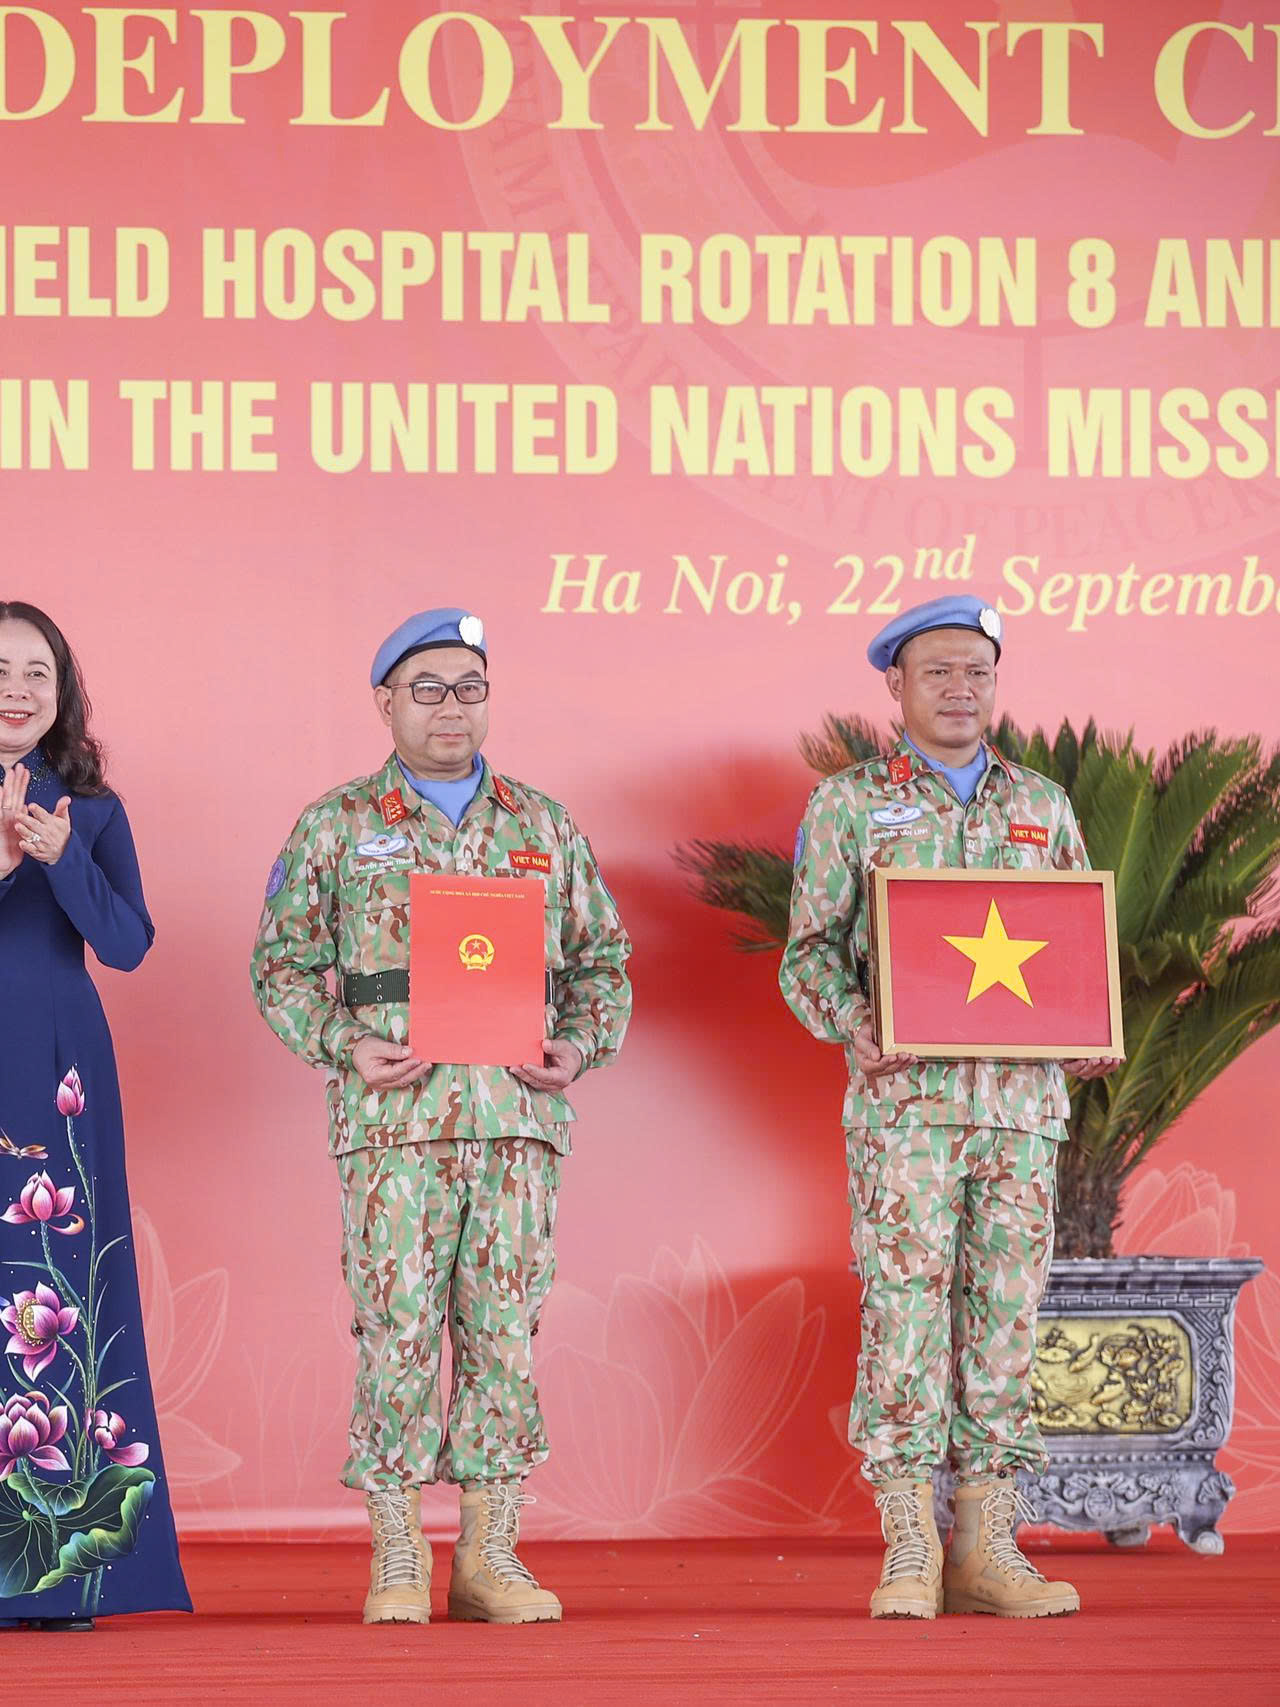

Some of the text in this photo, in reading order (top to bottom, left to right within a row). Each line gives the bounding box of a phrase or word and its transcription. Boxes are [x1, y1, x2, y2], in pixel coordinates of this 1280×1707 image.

[1154, 21, 1280, 138] C
[202, 227, 611, 324] HOSPITAL
[640, 233, 1037, 328] ROTATION
[1067, 236, 1117, 329] 8
[1143, 238, 1280, 328] AN
[0, 378, 89, 471] IN
[119, 380, 278, 472] THE
[310, 382, 619, 475] UNITED
[650, 385, 1017, 478] NATIONS
[1047, 387, 1280, 480] MISS
[541, 554, 640, 615] Ha
[663, 554, 802, 622] Noi,
[996, 555, 1280, 633] Septemb
[531, 856, 549, 868] NAM
[1030, 830, 1047, 842] NAM
